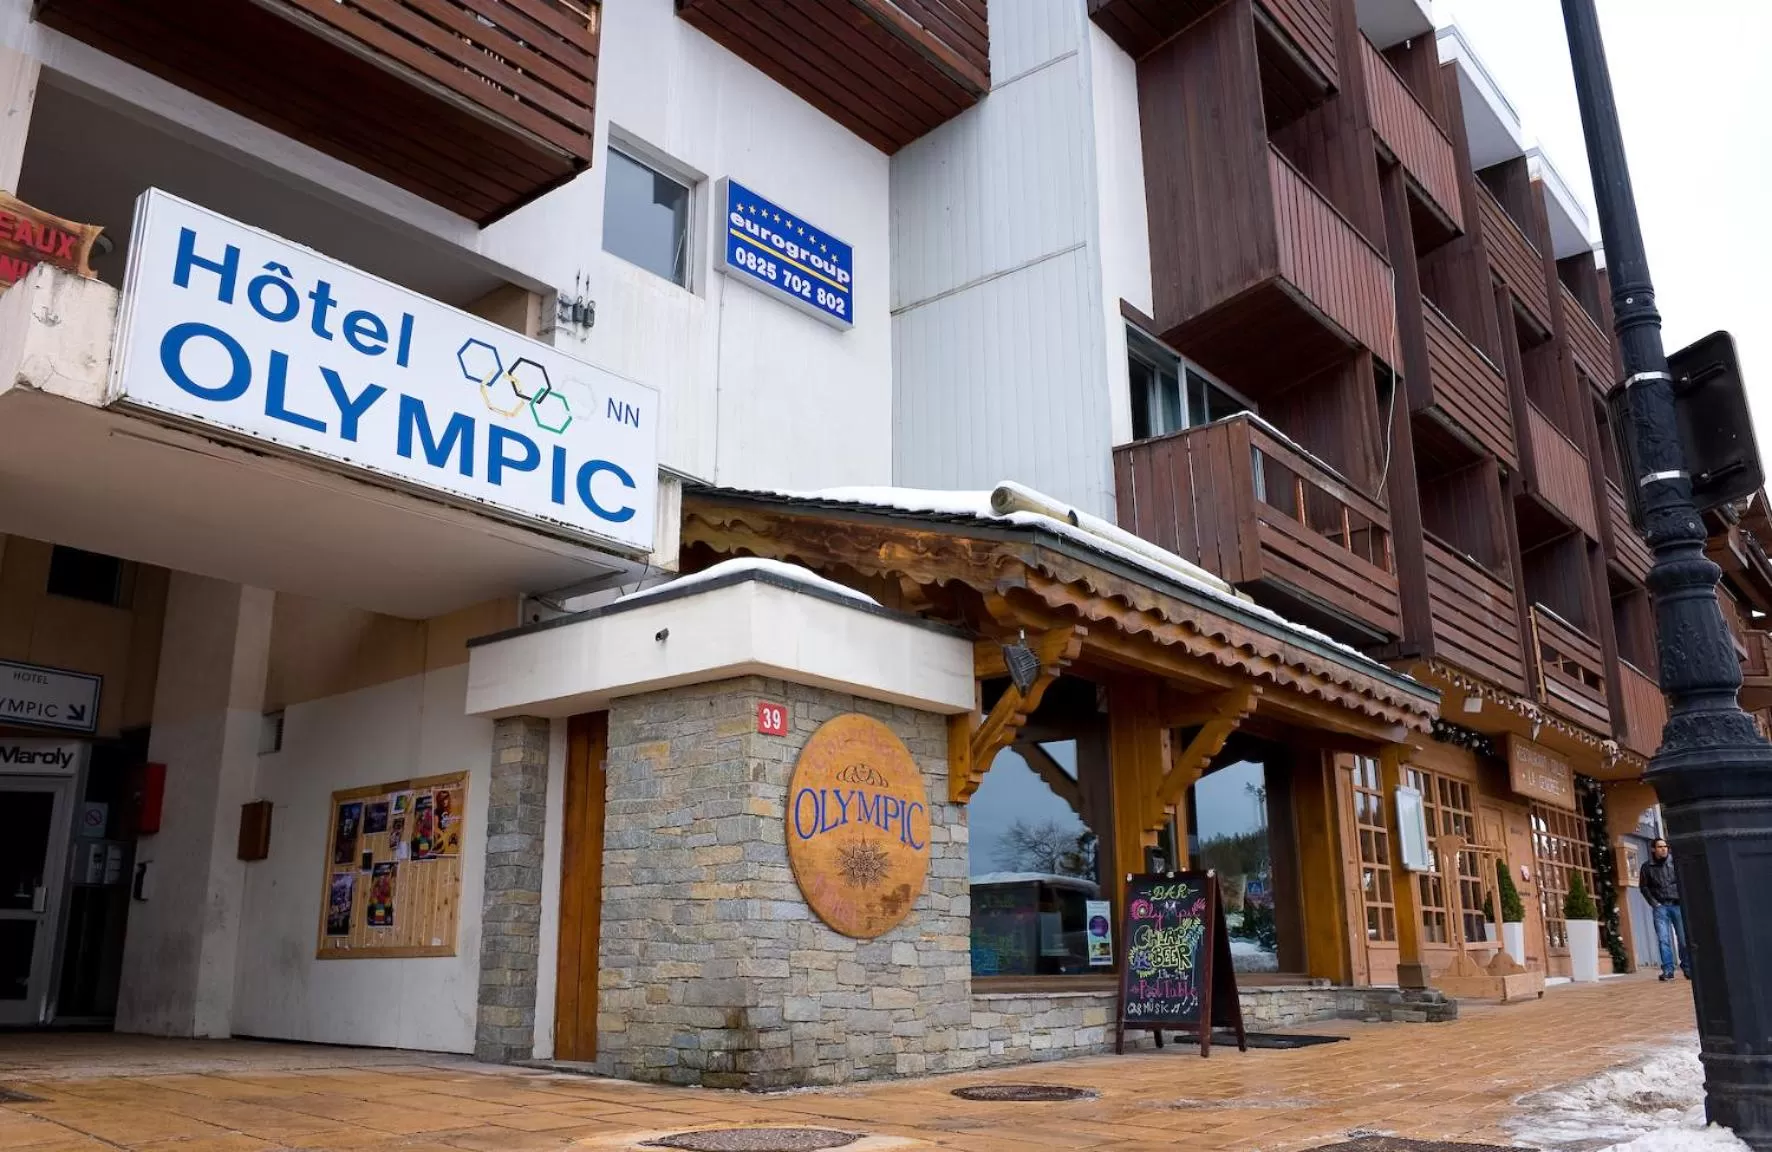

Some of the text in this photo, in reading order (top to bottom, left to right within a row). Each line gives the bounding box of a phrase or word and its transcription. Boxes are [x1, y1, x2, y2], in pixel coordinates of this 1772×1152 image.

[730, 212, 850, 283] eurogroup
[173, 226, 415, 368] Hôtel
[735, 247, 846, 316] 0825 702 802
[160, 322, 636, 523] OLYMPIC
[607, 397, 640, 429] NN
[13, 671, 49, 685] HOTEL
[763, 707, 782, 730] 39
[794, 788, 925, 850] OLYMPIC
[1151, 883, 1188, 901] BAR
[1151, 944, 1193, 970] BEER
